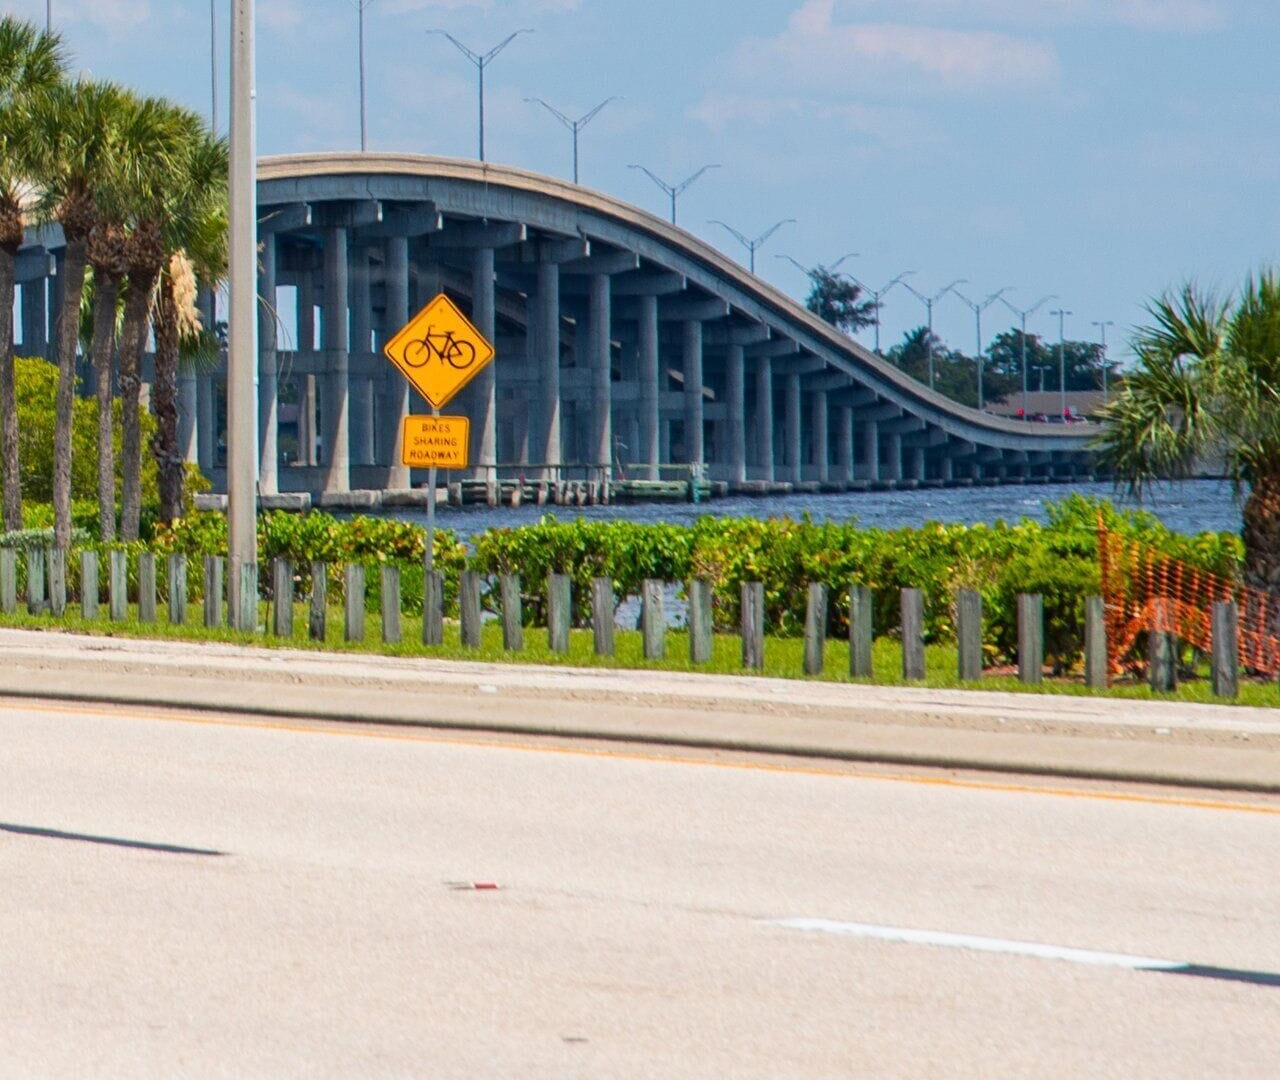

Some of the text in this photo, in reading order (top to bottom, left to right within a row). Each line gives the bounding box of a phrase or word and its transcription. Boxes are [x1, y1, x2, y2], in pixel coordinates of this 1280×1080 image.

[421, 423, 451, 433] BIKES
[413, 436, 457, 447] SHARING
[410, 450, 460, 460] ROADWAY
